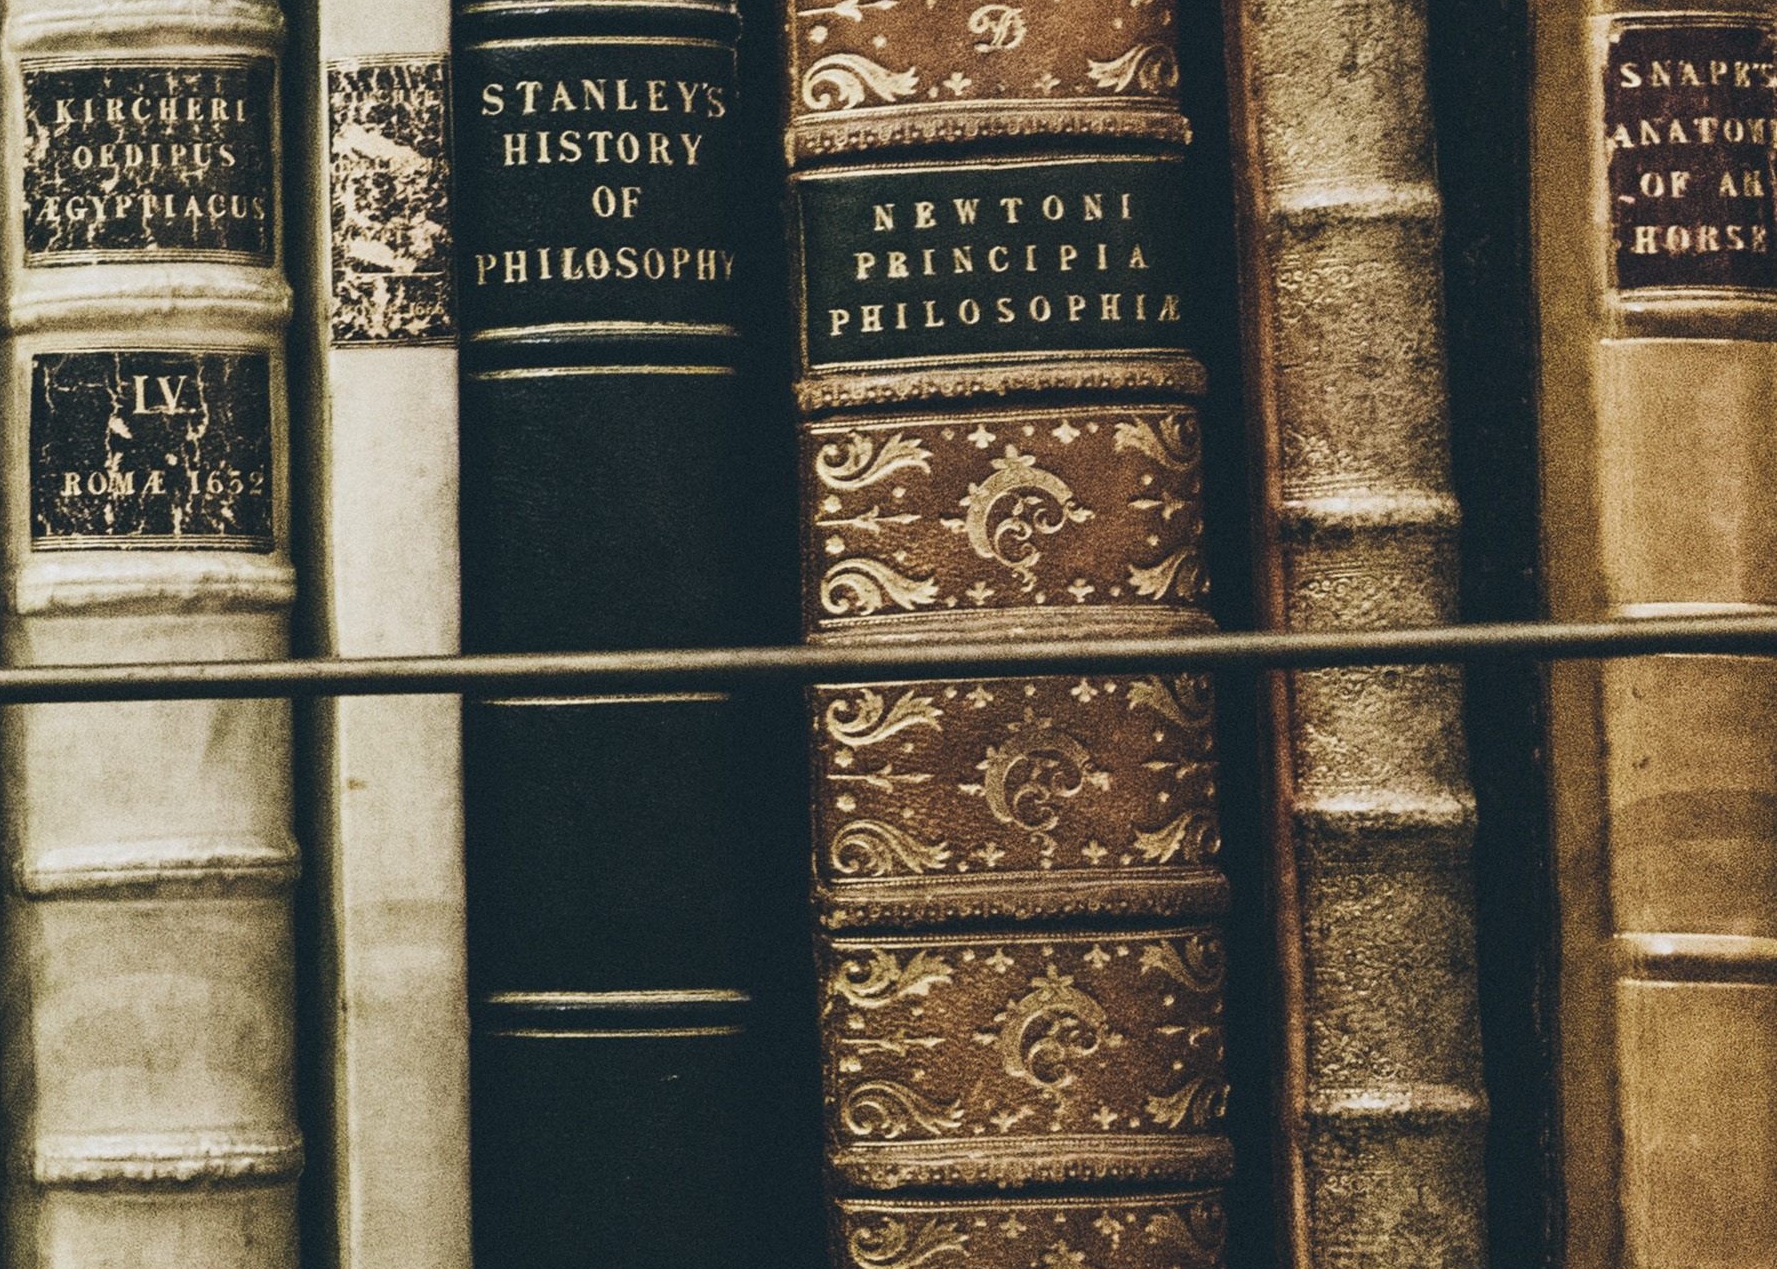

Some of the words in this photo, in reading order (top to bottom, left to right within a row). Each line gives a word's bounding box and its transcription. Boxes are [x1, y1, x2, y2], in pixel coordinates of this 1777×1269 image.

[56, 97, 245, 123] KIRCHERI
[481, 78, 725, 119] STANLEY'S
[72, 143, 236, 170] OEDIPUS
[503, 131, 702, 167] HISTORY
[592, 186, 641, 218] OF
[1640, 171, 1690, 198] OF
[873, 194, 1133, 231] NEWTONI
[476, 247, 735, 285] PHILOSOPHY
[854, 244, 1150, 280] PRINCIPIA
[829, 294, 1180, 337] PHILOSOPHIÆ
[133, 375, 188, 415] IV
[60, 470, 166, 496] ROMÆ
[190, 470, 264, 496] 1652
